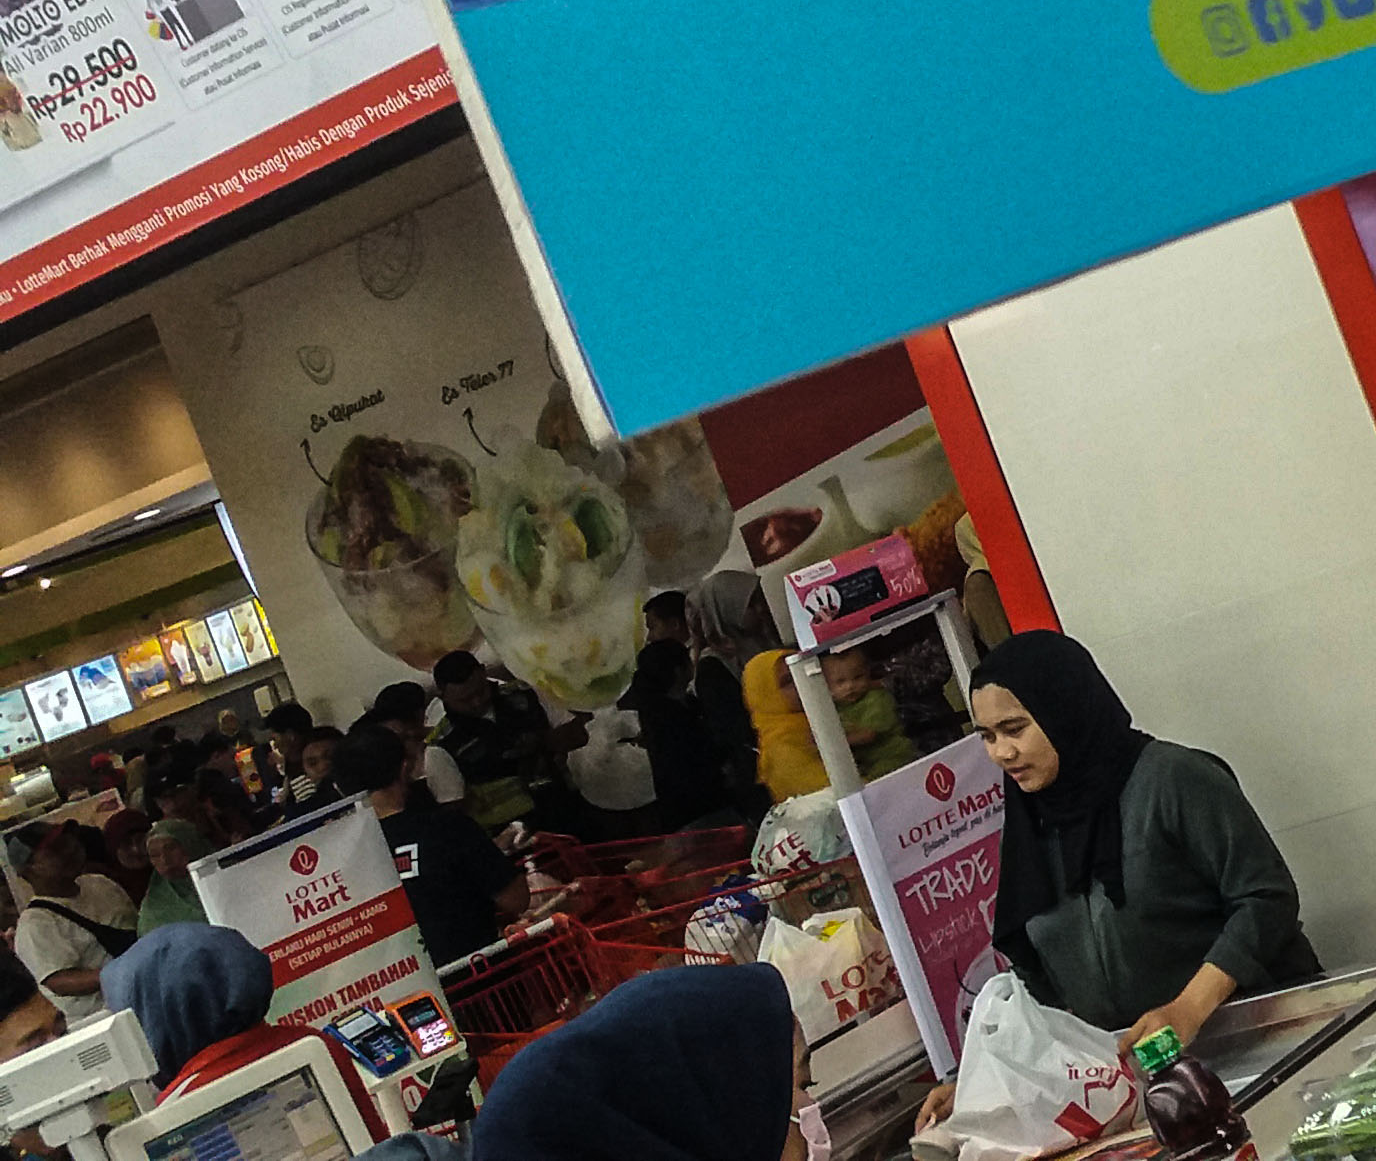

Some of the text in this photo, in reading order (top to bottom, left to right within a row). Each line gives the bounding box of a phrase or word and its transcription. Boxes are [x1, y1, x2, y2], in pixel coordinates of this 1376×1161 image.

[3, 6, 115, 76] All Varian 800ml
[16, 257, 71, 296] LotteMart
[69, 238, 110, 271] Berhak
[107, 208, 166, 252] Mengganti
[164, 187, 213, 224] Promosi
[209, 174, 241, 202] Yang
[319, 116, 368, 150] Dengan
[364, 93, 410, 125] Produk
[407, 68, 455, 104] Sejenis
[441, 386, 460, 405] Es
[497, 359, 514, 377] 77
[310, 414, 328, 433] Es
[898, 782, 1004, 849] LOTTE Mart
[285, 870, 344, 904] LOTTE
[292, 885, 351, 923] Mart
[906, 848, 994, 916] TRADE
[337, 954, 420, 1002] TAMBAHAN
